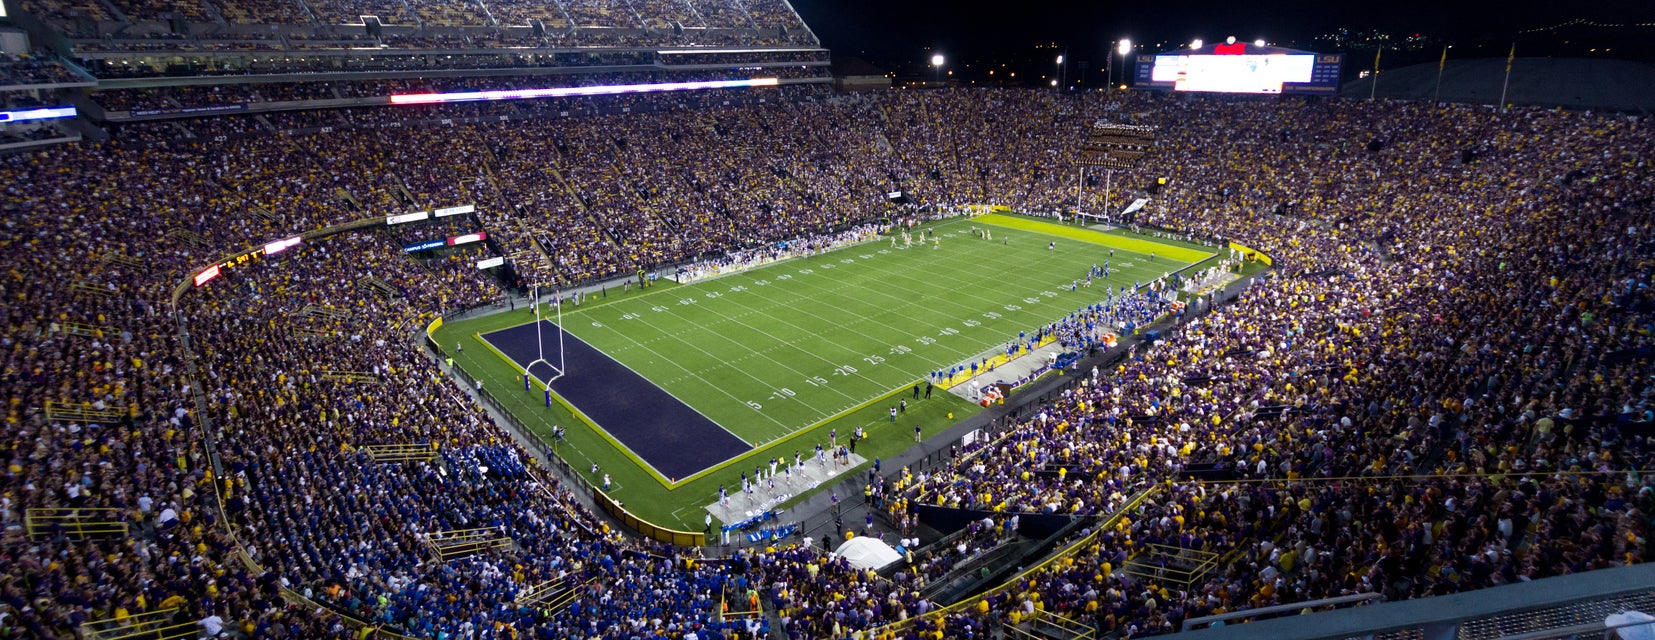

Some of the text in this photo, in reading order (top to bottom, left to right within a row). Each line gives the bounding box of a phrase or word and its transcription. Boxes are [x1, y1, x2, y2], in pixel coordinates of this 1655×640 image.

[940, 327, 959, 336] 40
[916, 336, 936, 345] 35
[891, 345, 912, 355] 30
[864, 354, 886, 365] 25
[835, 365, 858, 376] 20
[805, 375, 828, 387] 15
[772, 388, 796, 400] 10
[747, 400, 762, 410] 5
